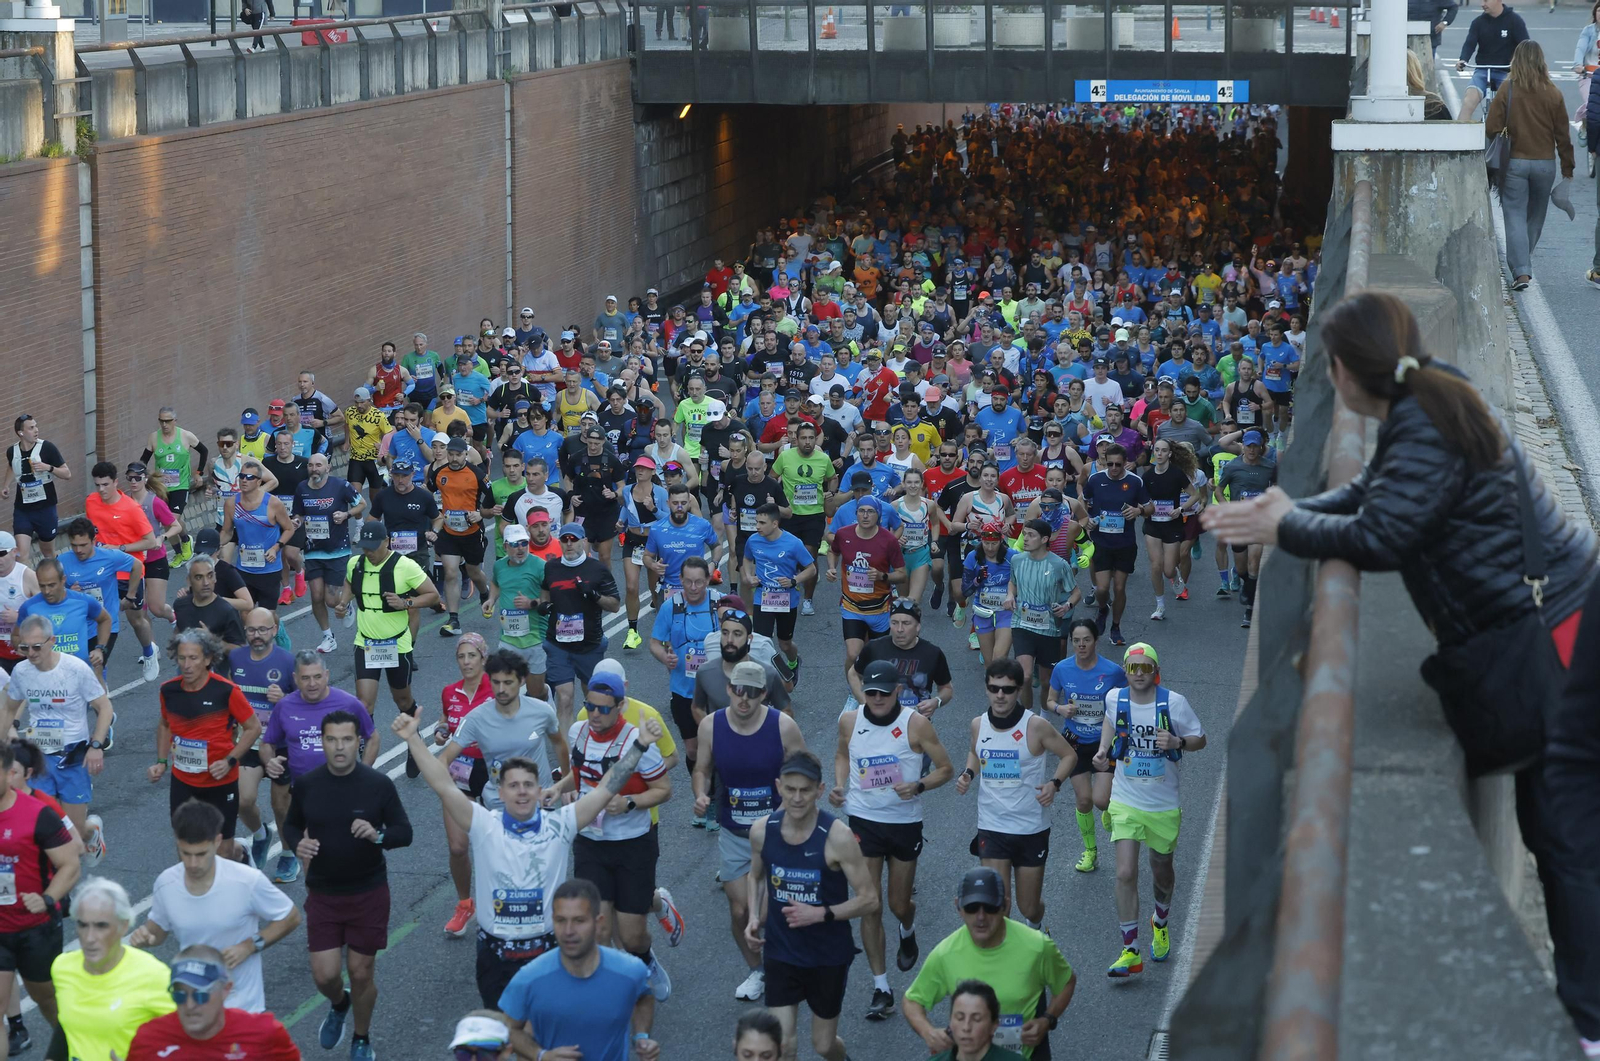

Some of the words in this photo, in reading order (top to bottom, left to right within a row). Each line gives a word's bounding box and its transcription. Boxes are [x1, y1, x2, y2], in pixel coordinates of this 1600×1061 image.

[1091, 86, 1100, 96] 4
[1218, 87, 1226, 97] 4
[1114, 93, 1159, 101] DELEGACIÓN
[789, 370, 804, 378] 1519
[26, 689, 68, 698] GIOVANNI
[1075, 709, 1104, 717] ANCESCA
[180, 740, 204, 748] ZURICH
[175, 755, 202, 766] ARTURO
[871, 757, 894, 765] ZURICH
[871, 777, 893, 787] TALAI
[743, 808, 773, 817] ANDERSON
[776, 889, 818, 902] DIETMAR
[495, 915, 520, 924] ALVARO
[521, 914, 544, 923] MUÑIZ
